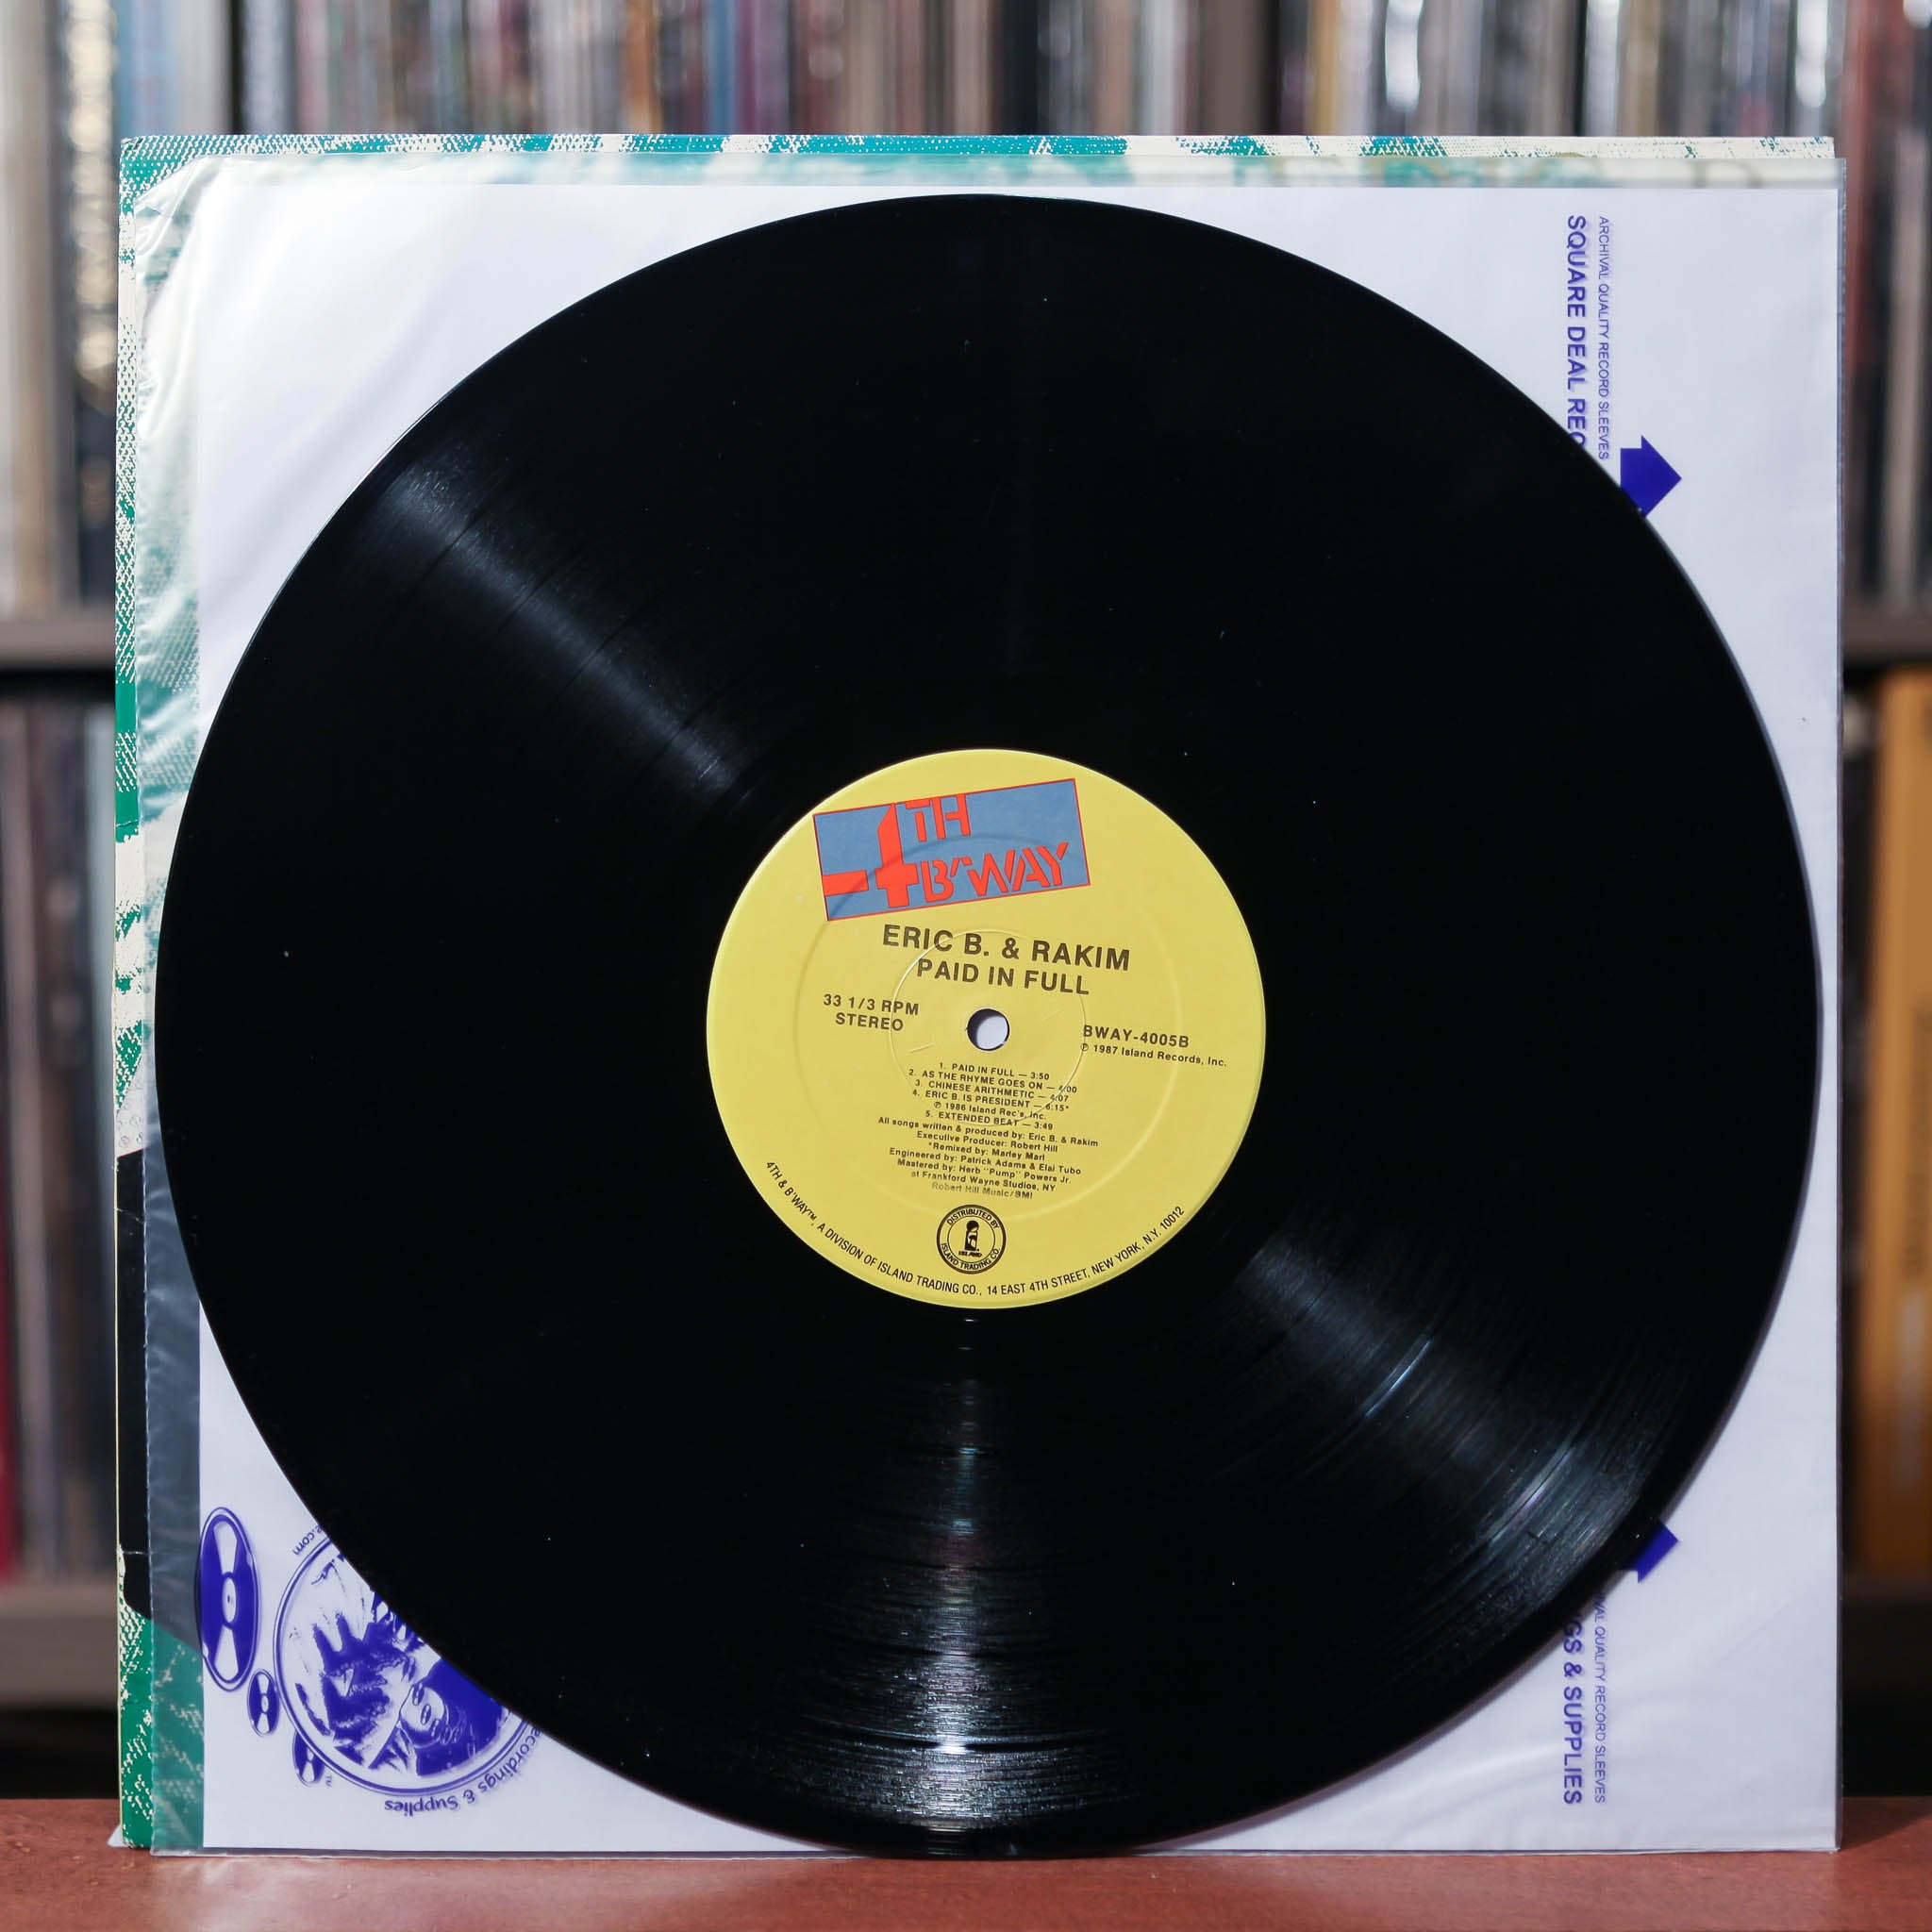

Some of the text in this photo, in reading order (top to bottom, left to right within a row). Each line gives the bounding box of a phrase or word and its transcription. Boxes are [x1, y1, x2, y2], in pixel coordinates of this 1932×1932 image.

[1567, 215, 1587, 318] SQUARE
[1598, 216, 1609, 460] ARCHIVAL QUALITY RECORD SLEEVES
[1567, 326, 1586, 391] DEAL
[883, 924, 1130, 971] ERIC B. & RAKIM
[917, 958, 1089, 995] PAID IN FULL
[823, 993, 919, 1016] 33 1/3 RPM
[835, 1012, 904, 1031] STEREO
[1083, 1024, 1189, 1048] BWAY-4005B
[1093, 1044, 1118, 1055] 1987
[1121, 1047, 1154, 1058] Island
[1157, 1051, 1204, 1065] Records,
[1208, 1057, 1226, 1067] Inc.
[922, 1070, 935, 1078] AS
[938, 1072, 957, 1081] THE
[960, 1074, 994, 1085] RHYME
[998, 1077, 1025, 1089] GOES
[1028, 1081, 1043, 1090] ON
[952, 1063, 975, 1073] PAID
[991, 1067, 1015, 1077] FULL
[1030, 1072, 1049, 1081] 3:50
[924, 1090, 948, 1100] ERIC
[975, 1095, 1030, 1108] PRESIDENT
[928, 1080, 971, 1092] CHINESE
[974, 1085, 1035, 1099] ARITHMETIC
[938, 1111, 991, 1124] EXTENDED
[993, 1117, 1019, 1126] BEAT
[1034, 1121, 1053, 1130] 3:49
[945, 1102, 966, 1111] 1986
[969, 1105, 996, 1115] Island
[892, 1120, 919, 1129] songs
[923, 1123, 953, 1131] written
[965, 1127, 1009, 1138] produced
[1011, 1130, 1025, 1141] by:
[1028, 1132, 1045, 1141] Eric
[1070, 1137, 1098, 1147] Rakim
[917, 1130, 1058, 1153] Executive Producer: Robert Hill
[890, 1147, 941, 1160] Engineered
[943, 1153, 958, 1163] by:
[960, 1155, 991, 1165] Patrick
[995, 1158, 1026, 1169] Adams
[1058, 1165, 1081, 1174] Tubo
[974, 1146, 989, 1157] by:
[1025, 1152, 1045, 1160] Marl
[897, 1158, 940, 1170] Mastered
[941, 1162, 956, 1173] by:
[958, 1165, 981, 1174] Herb
[1024, 1172, 1057, 1182] Powers
[922, 1171, 966, 1183] Frankford
[970, 1175, 1000, 1187] Wayne
[1003, 1179, 1040, 1191] Studios,
[1042, 1183, 1056, 1191] NY
[932, 1181, 962, 1192] Robert
[965, 1185, 979, 1193] Hill
[766, 1161, 783, 1180] 4TH
[777, 1179, 788, 1189] &
[816, 1223, 825, 1233] A
[824, 1228, 864, 1260] DIVISION
[863, 1254, 878, 1267] OF
[876, 1260, 913, 1283] ISLAND
[916, 1274, 959, 1293] TRADING
[987, 1285, 998, 1295] 14
[1001, 1283, 1026, 1295] EAST
[1029, 1279, 1049, 1291] 4TH
[1091, 1257, 1114, 1275] NEW
[1159, 1206, 1185, 1230] 10012
[1594, 1625, 1606, 1683] QUALITY
[1563, 1662, 1582, 1677] &
[1594, 1685, 1606, 1742] RECORD
[1563, 1686, 1582, 1805] SUPPLIES
[477, 1724, 541, 1793] ecordings
[1594, 1745, 1606, 1804] SLEEVES
